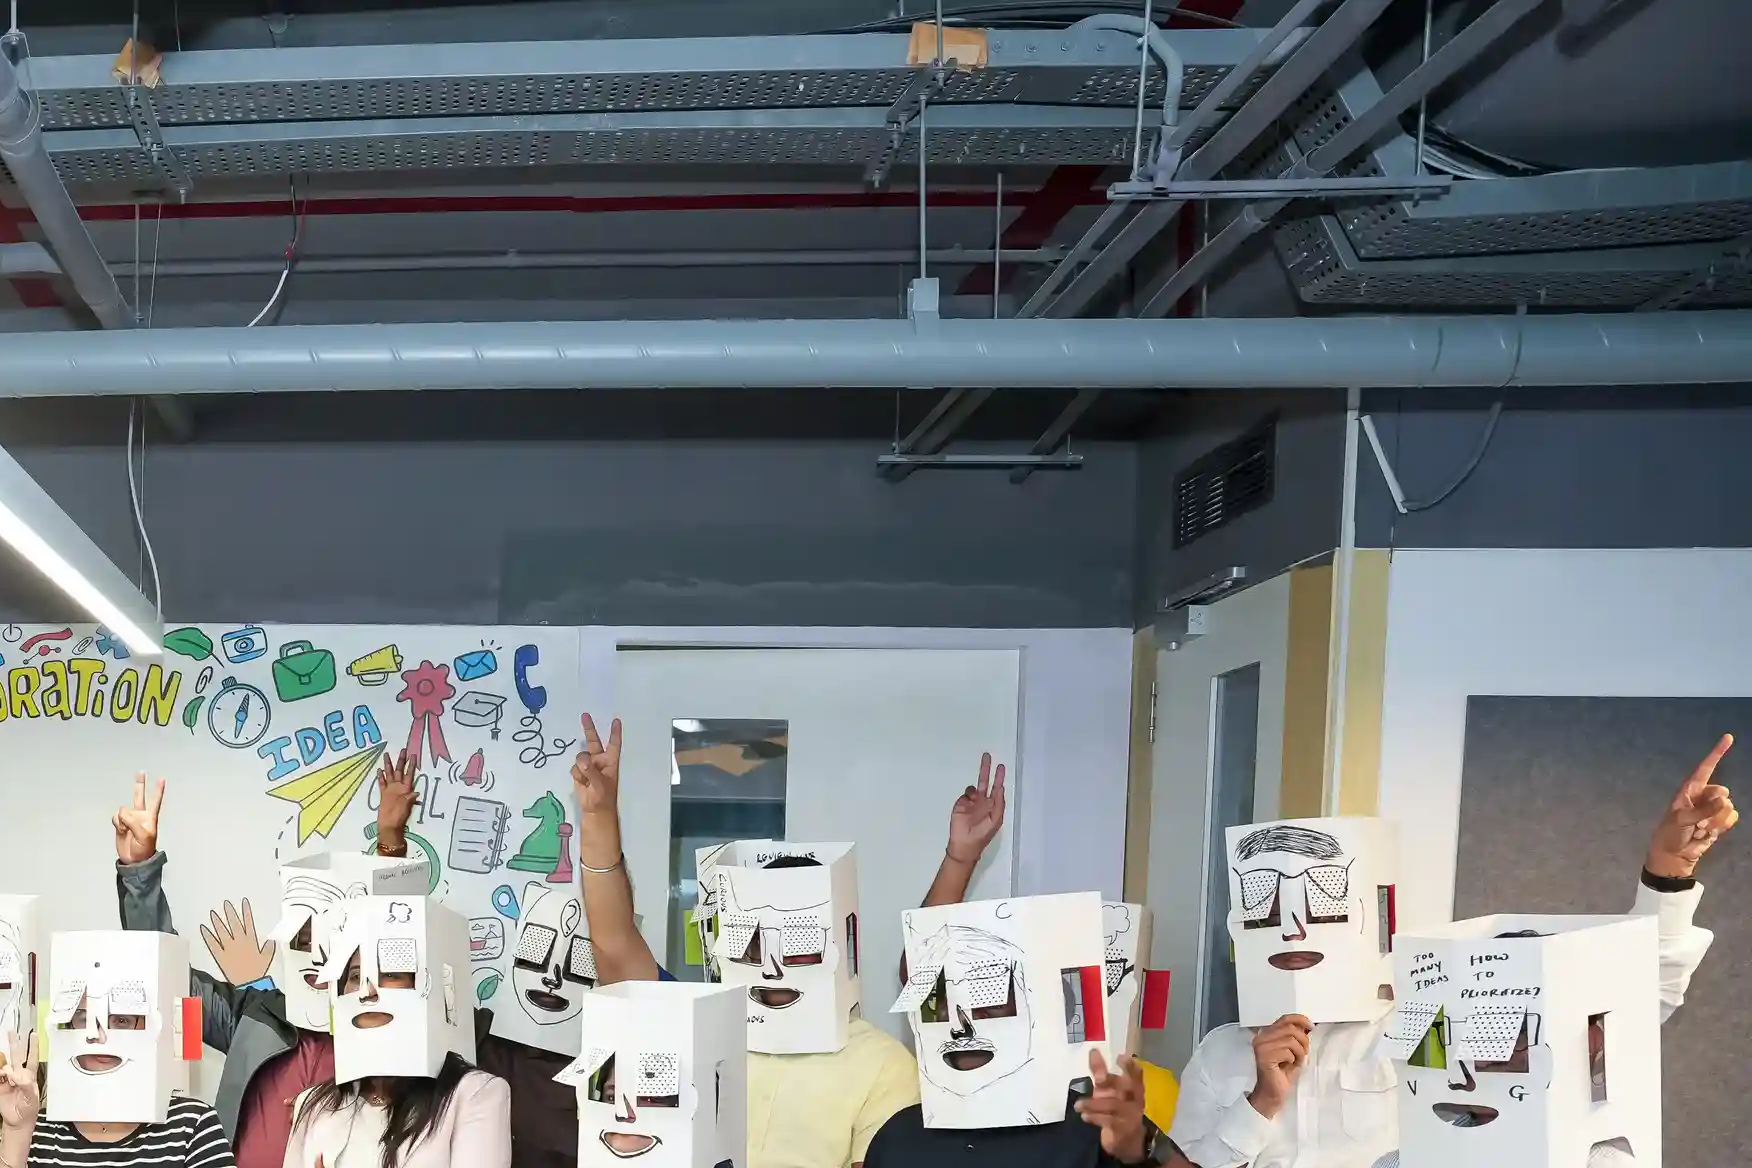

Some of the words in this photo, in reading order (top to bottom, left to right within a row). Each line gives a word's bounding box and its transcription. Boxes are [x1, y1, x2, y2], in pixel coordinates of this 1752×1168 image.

[257, 704, 382, 781] IDEA
[1413, 952, 1434, 963] TOO
[1470, 953, 1509, 966] HOW
[1410, 961, 1442, 977] MANY
[1473, 971, 1495, 981] TO
[1414, 974, 1449, 992] IDEAS
